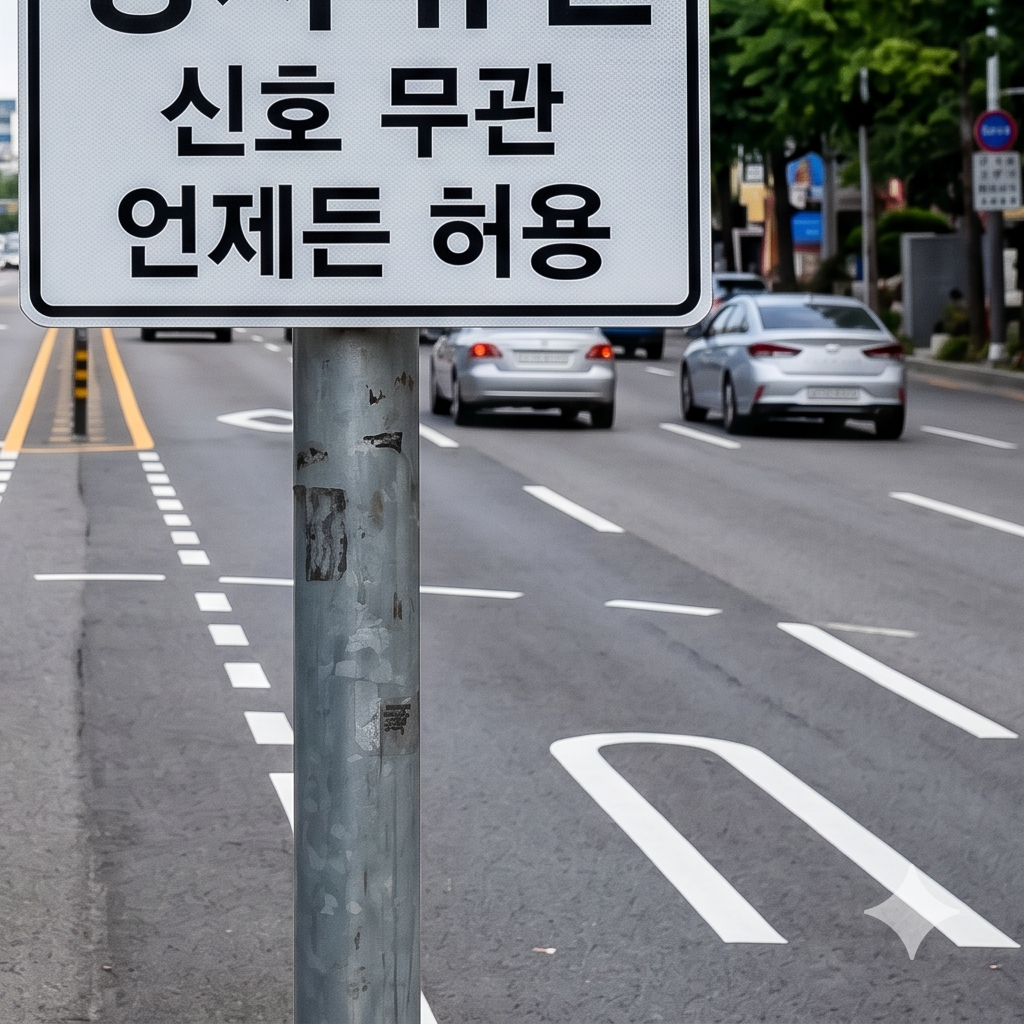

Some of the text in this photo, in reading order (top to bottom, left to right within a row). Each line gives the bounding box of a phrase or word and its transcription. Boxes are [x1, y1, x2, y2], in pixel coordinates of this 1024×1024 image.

[160, 64, 565, 160] 신호 무관
[118, 183, 612, 282] 언제든 허용
